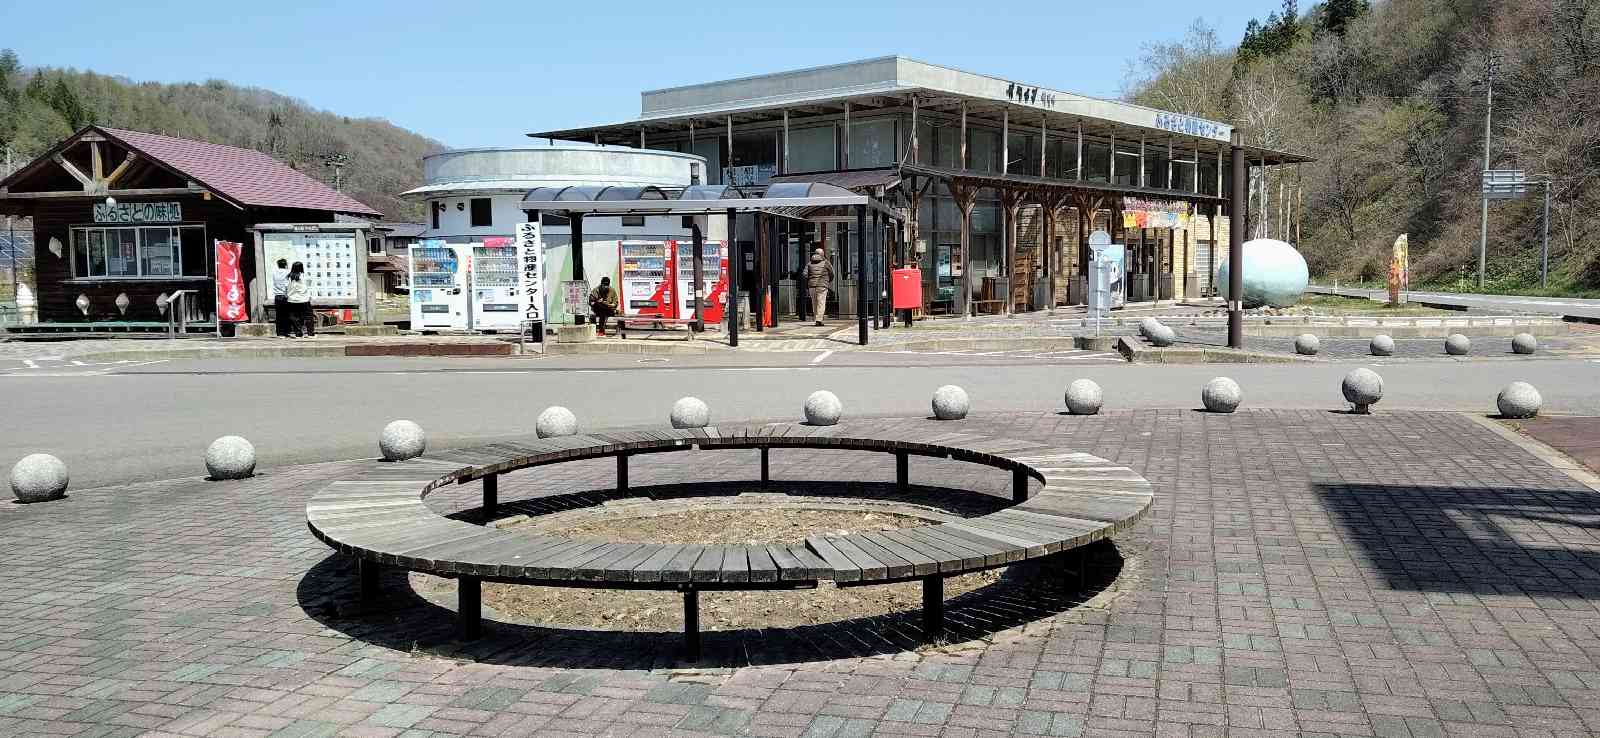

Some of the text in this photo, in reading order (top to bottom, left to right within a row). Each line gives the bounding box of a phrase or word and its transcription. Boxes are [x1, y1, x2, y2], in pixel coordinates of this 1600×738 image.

[96, 204, 180, 223] ふるさとの味処
[521, 223, 539, 319] ふるさと物産センター入口
